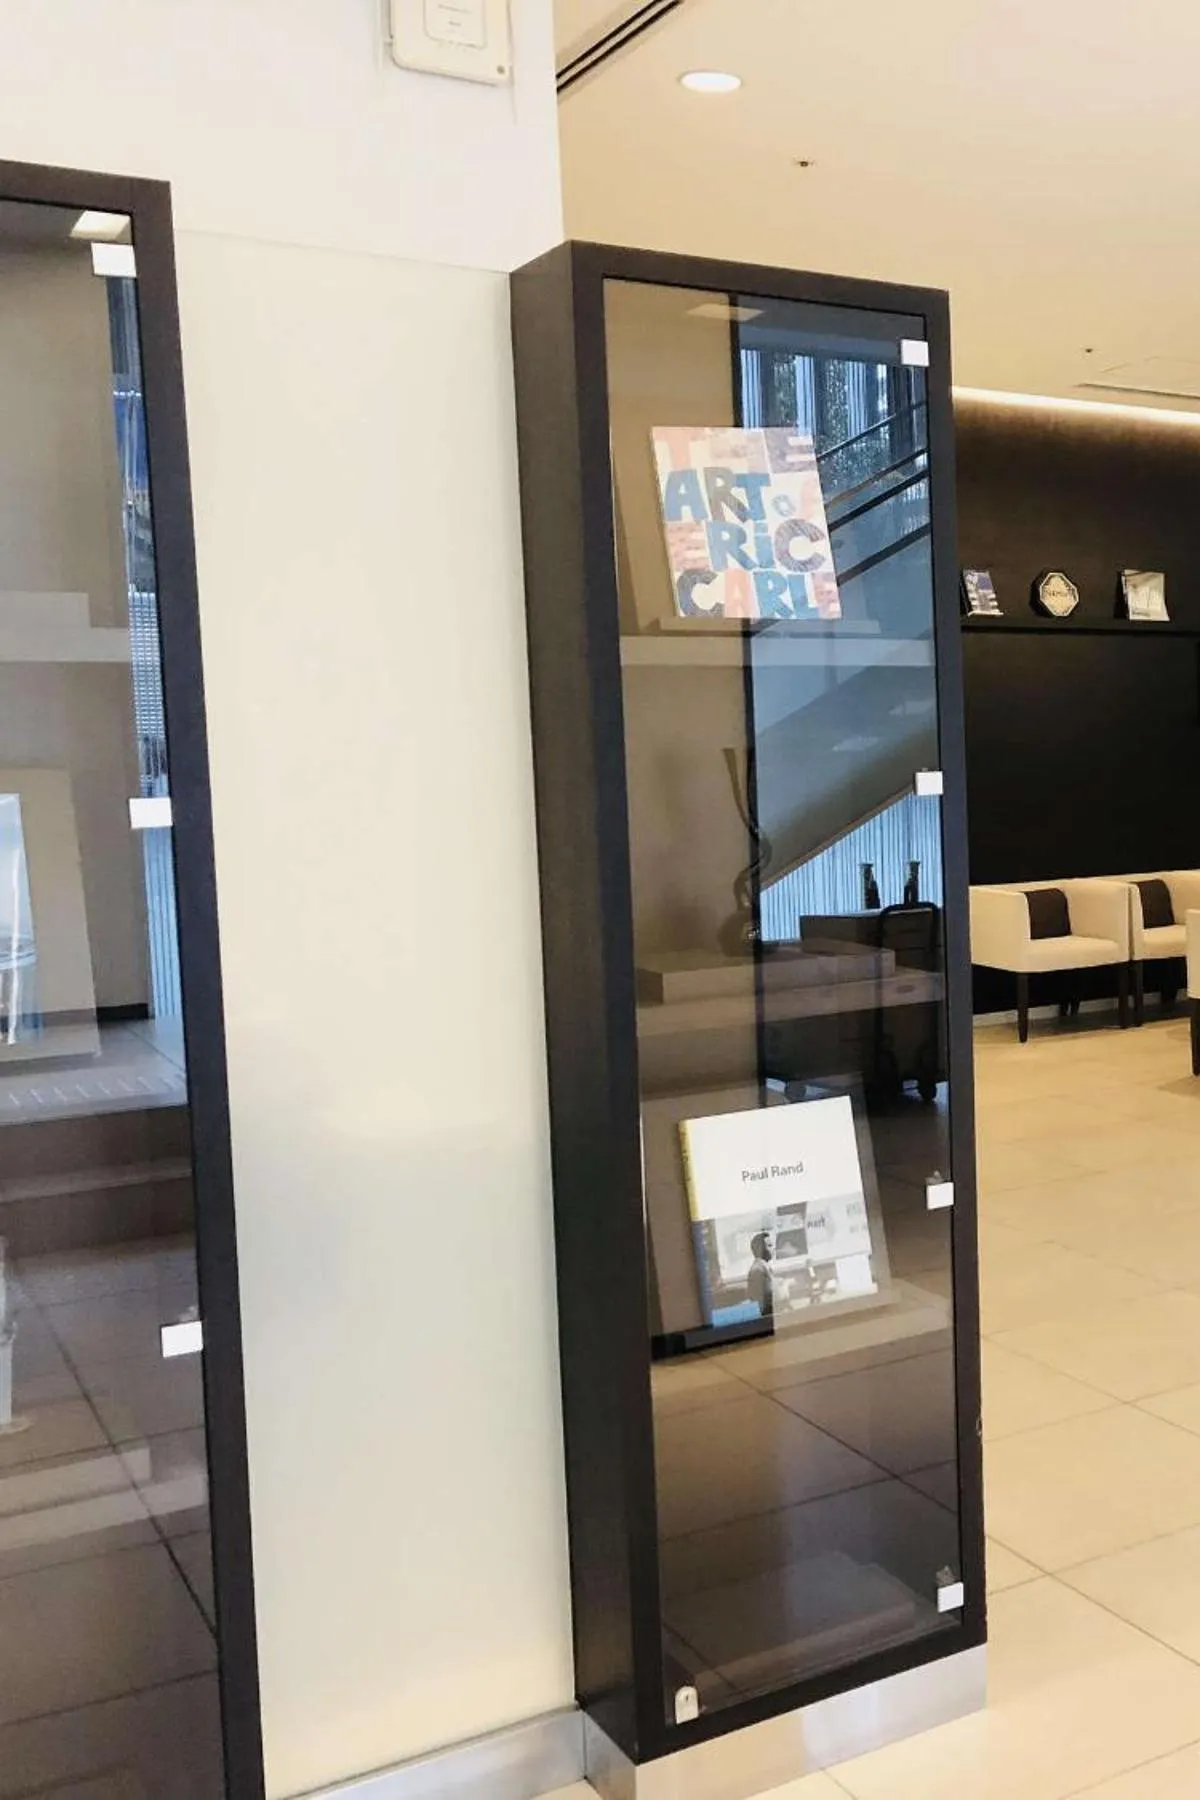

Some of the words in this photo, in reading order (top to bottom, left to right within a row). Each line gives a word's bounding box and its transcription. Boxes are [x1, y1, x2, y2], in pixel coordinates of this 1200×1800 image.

[664, 467, 771, 523] ART
[676, 568, 841, 619] CARLE
[741, 1167, 769, 1182] Paul
[771, 1162, 804, 1178] Rand
